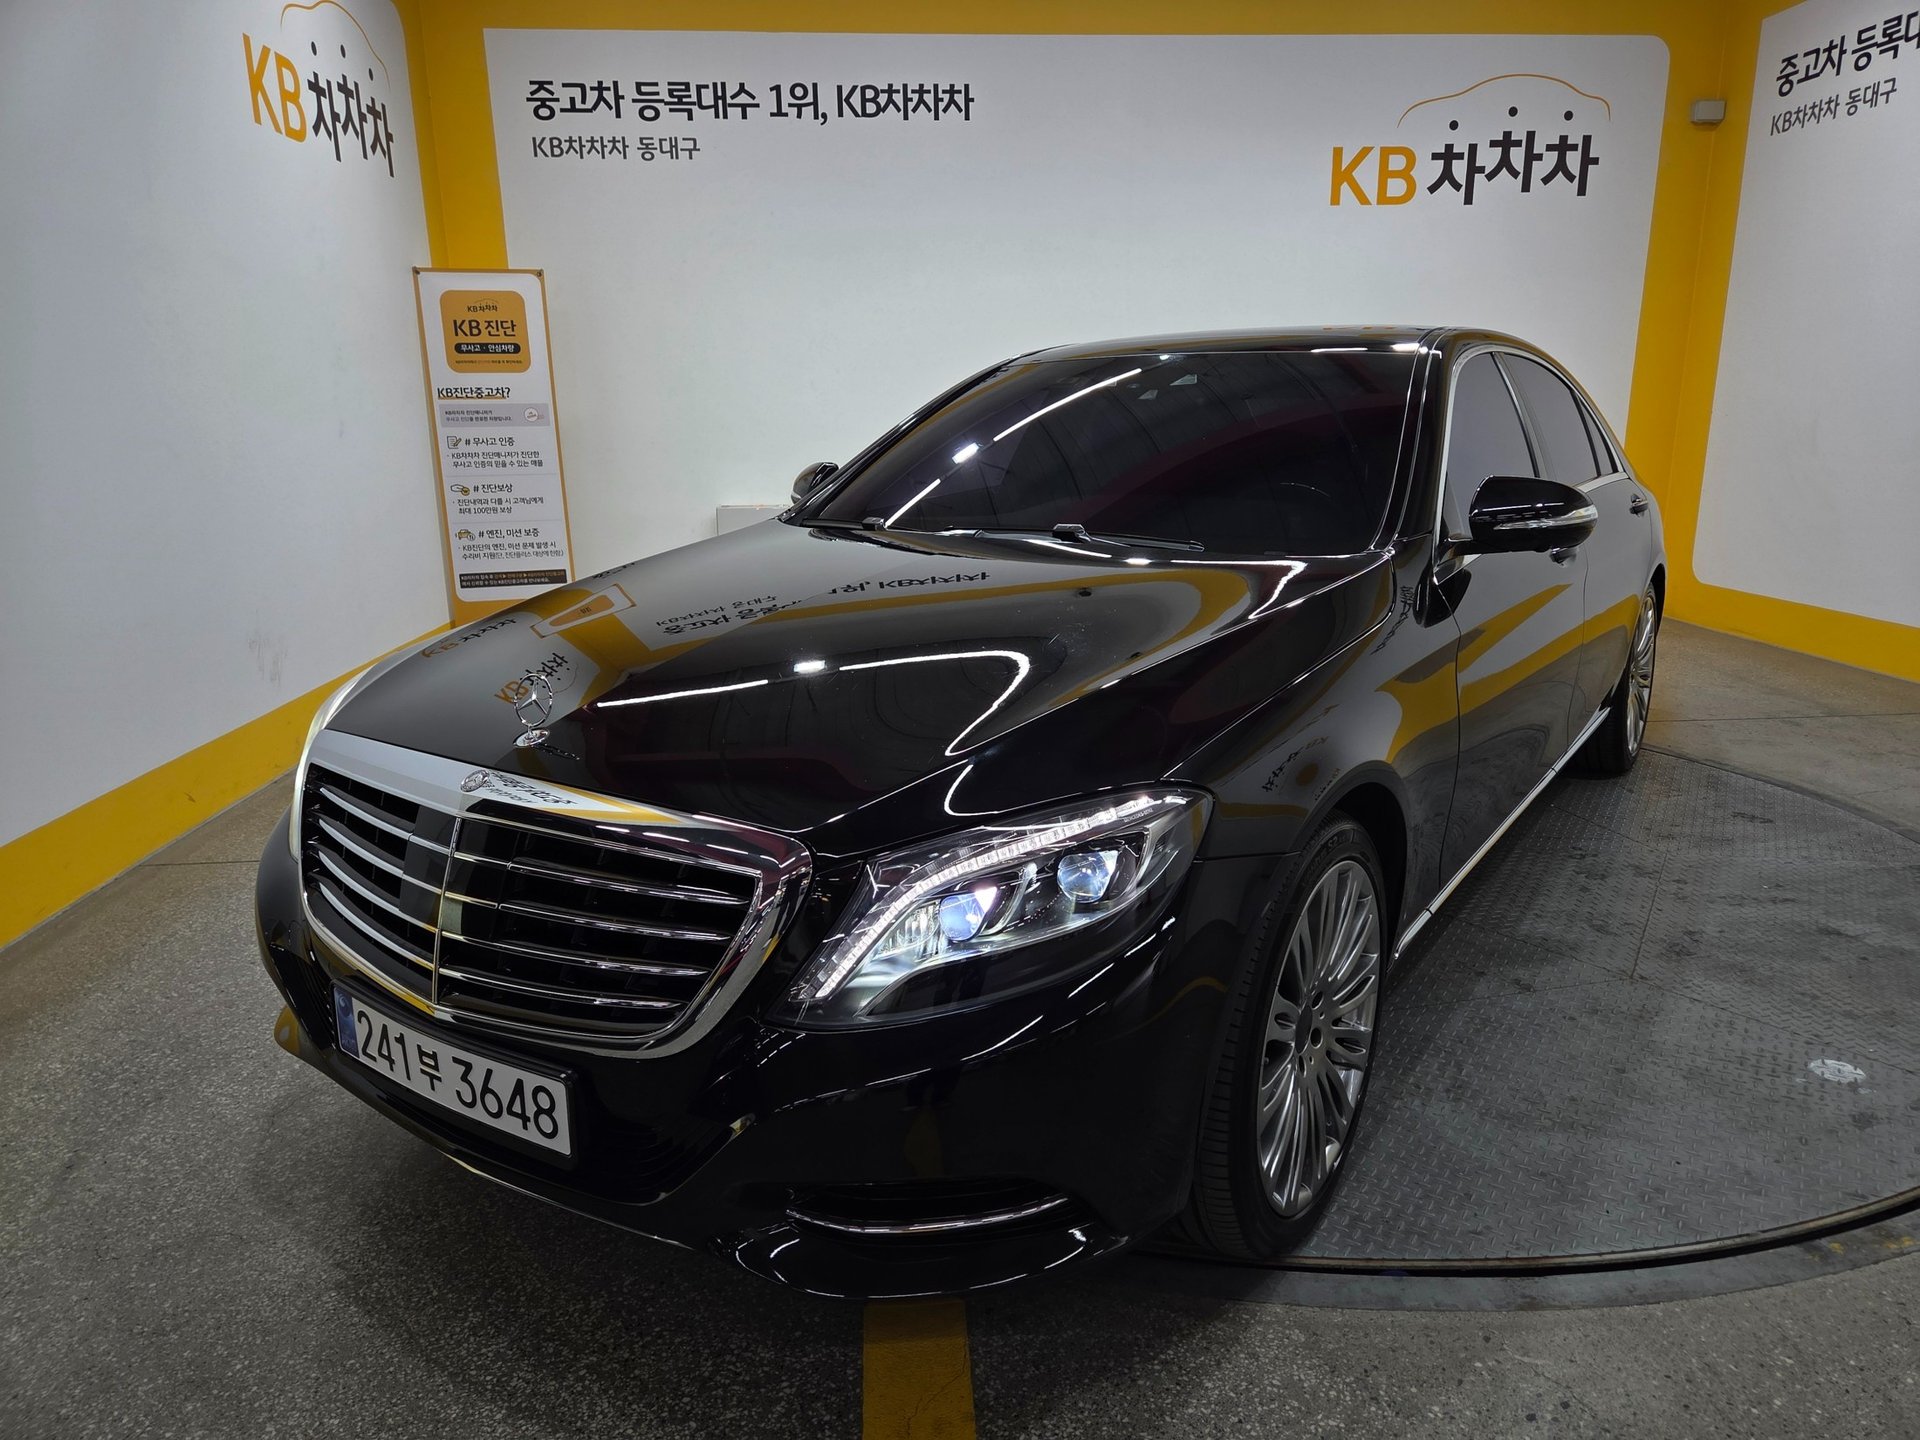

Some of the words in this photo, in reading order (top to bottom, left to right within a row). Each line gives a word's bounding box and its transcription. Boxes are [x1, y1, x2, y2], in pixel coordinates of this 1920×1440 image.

[1776, 35, 1847, 97] 중고차
[526, 80, 625, 121] 중고차
[631, 80, 760, 121] 등록대수
[769, 82, 828, 125] 1위,
[837, 83, 975, 121] KB차차차
[1770, 94, 1840, 136] KB차차차
[1846, 78, 1897, 116] 동대구
[532, 135, 629, 159] KB차차차
[636, 136, 701, 161] 동대구
[453, 320, 482, 337] KB
[484, 320, 517, 337] 진단
[488, 344, 515, 353] 안심차량
[437, 387, 511, 399] KB진단중고차?
[472, 437, 497, 447] 무사고
[498, 436, 516, 446] 인증
[451, 452, 480, 460] KB차차차
[481, 451, 519, 459] 진단매니저가
[520, 450, 540, 459] 진단한
[508, 460, 516, 468] 수
[517, 460, 530, 468] 있는
[481, 483, 513, 493] 진단보상
[457, 498, 489, 506] 진단내역과
[505, 497, 512, 505] 시
[512, 497, 544, 505] 고객님에게
[486, 529, 505, 539] 엔진,
[524, 528, 540, 538] 보증
[550, 541, 556, 549] 시
[462, 552, 481, 560] 수리비
